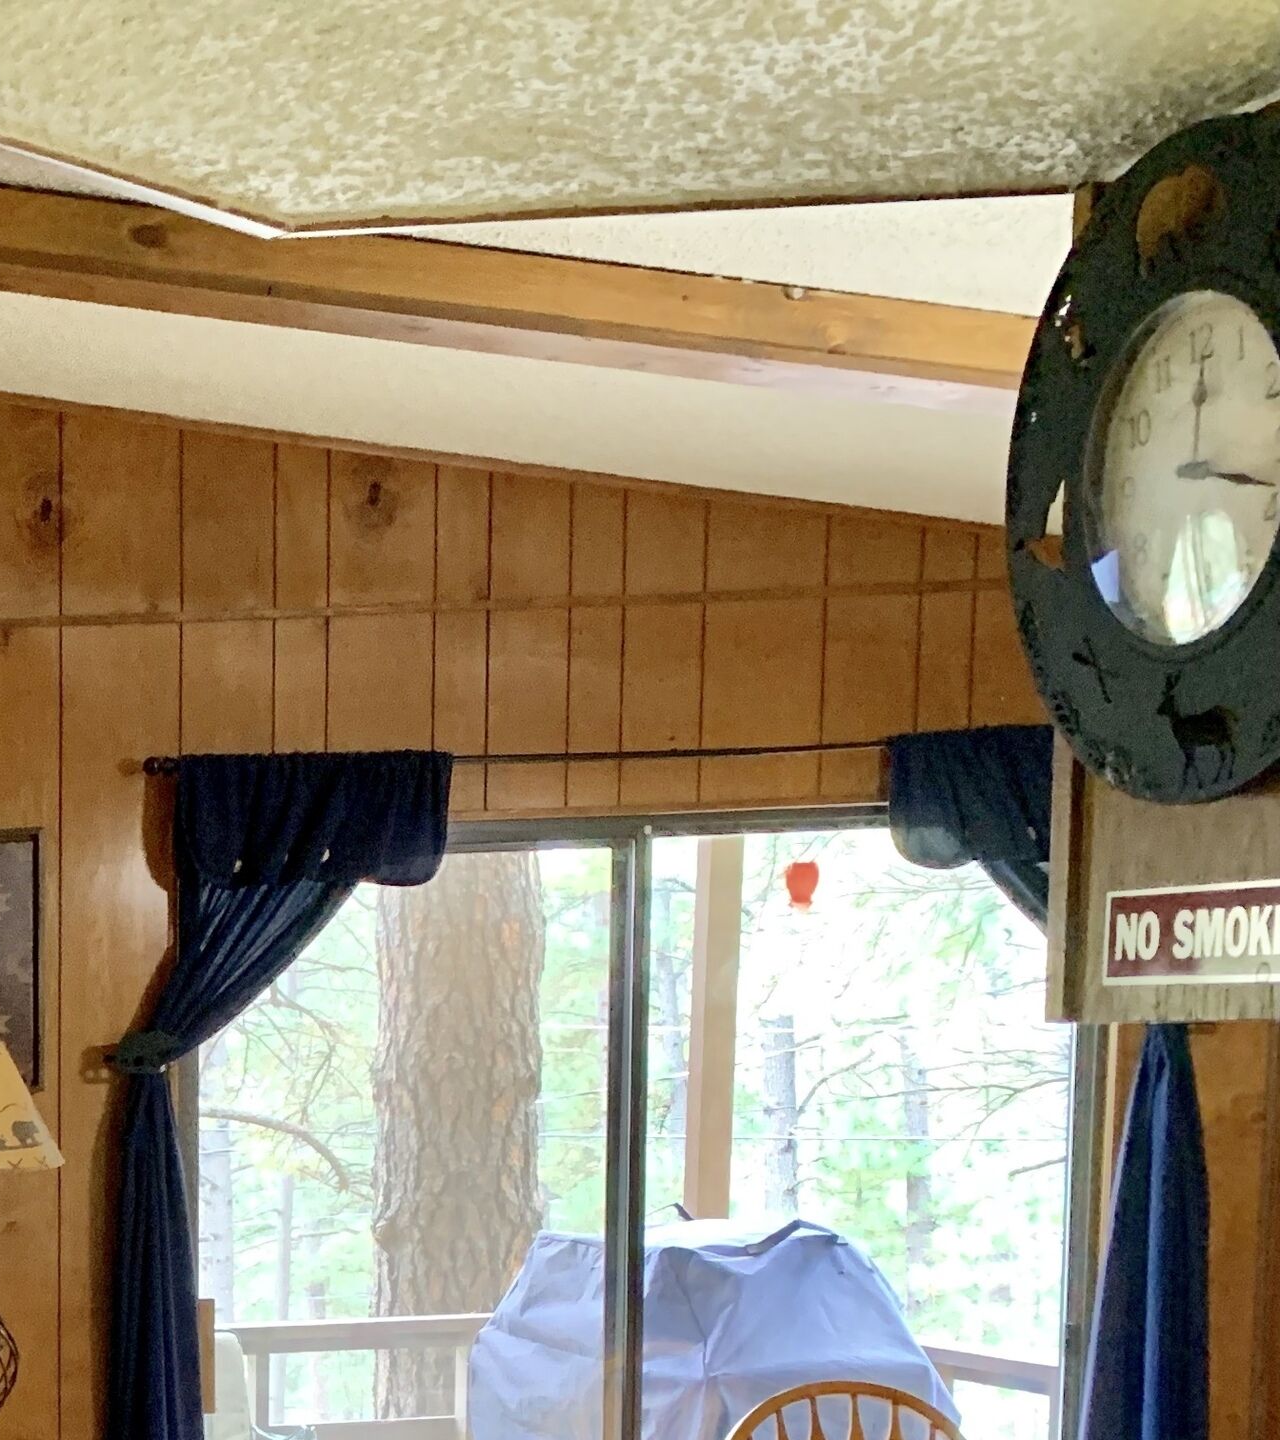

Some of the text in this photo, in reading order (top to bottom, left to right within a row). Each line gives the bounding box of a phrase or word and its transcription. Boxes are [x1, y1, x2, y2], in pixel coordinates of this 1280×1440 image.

[1189, 321, 1215, 364] 12
[1237, 323, 1245, 362] 1
[1154, 354, 1172, 394] 11
[1117, 409, 1152, 450] 10
[1115, 910, 1160, 961] NO
